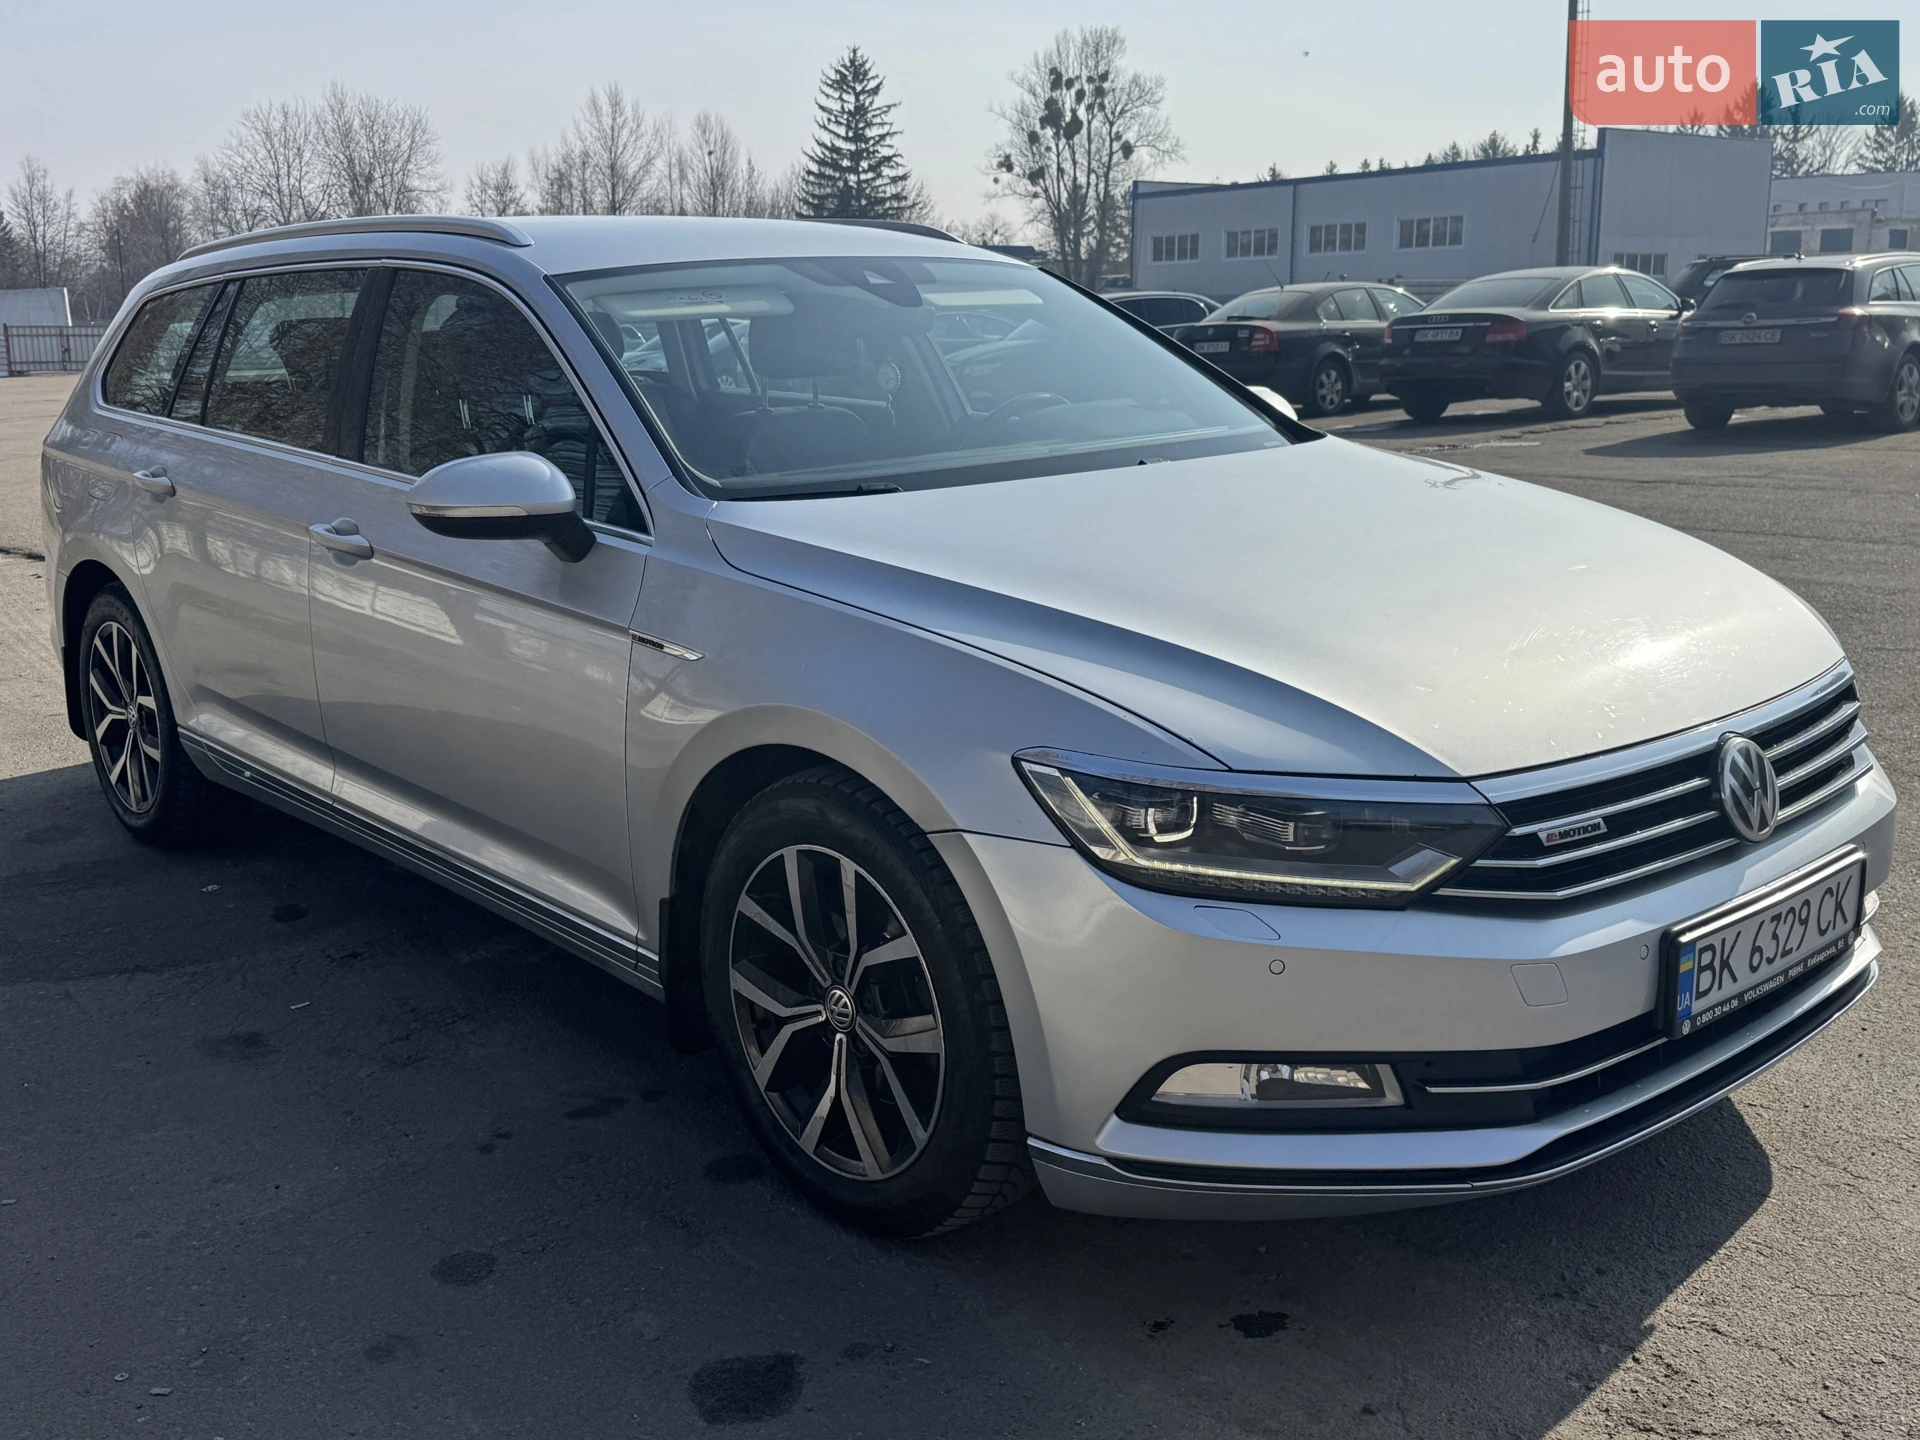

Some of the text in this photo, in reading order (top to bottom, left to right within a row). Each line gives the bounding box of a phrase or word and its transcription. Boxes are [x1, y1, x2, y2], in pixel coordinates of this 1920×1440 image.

[1546, 821, 1601, 844] 4MOTION
[1694, 875, 1853, 1002] BK 6329 CK
[1677, 991, 1691, 1011] UA
[1696, 1017, 1702, 1026] 0
[1702, 1010, 1714, 1023] 800
[1714, 1006, 1722, 1017] 30
[1743, 974, 1784, 1002] VOLKSWAGEN
